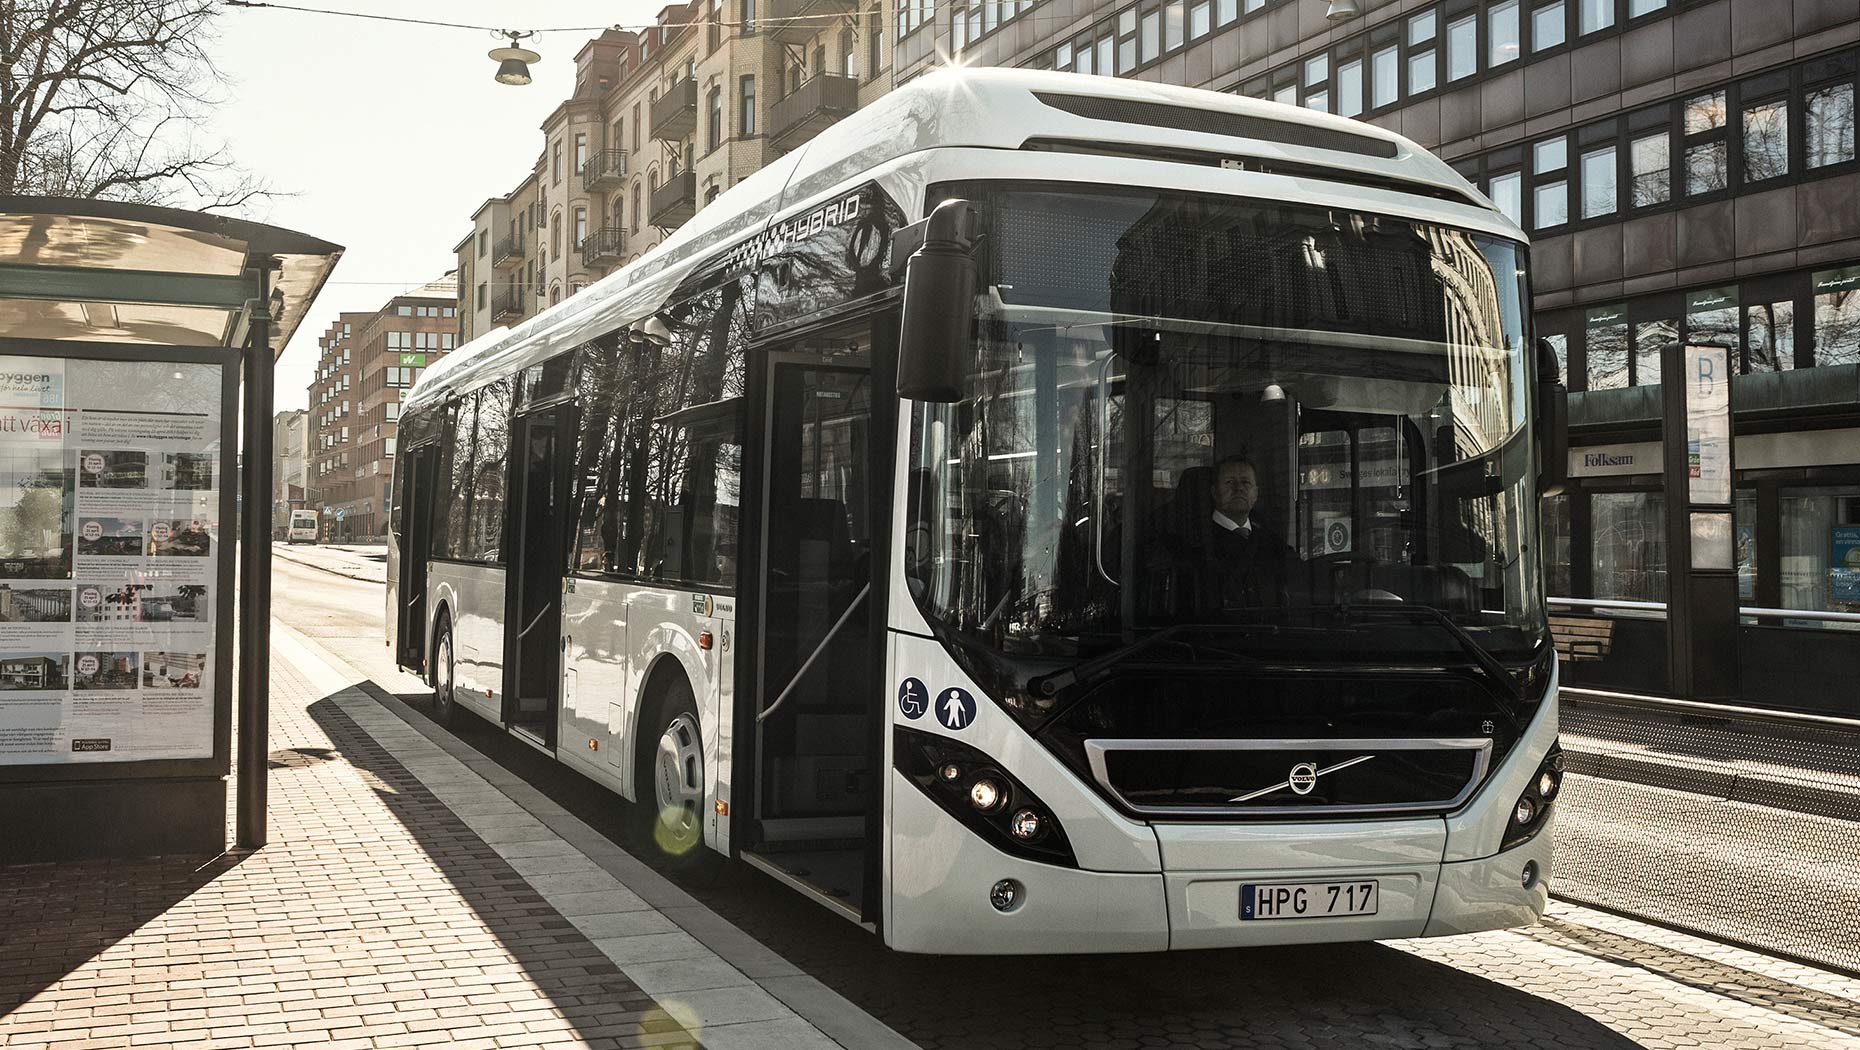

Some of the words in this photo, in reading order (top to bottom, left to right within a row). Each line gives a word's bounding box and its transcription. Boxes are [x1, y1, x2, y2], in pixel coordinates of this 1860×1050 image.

[784, 194, 860, 246] HYBRID
[20, 416, 61, 434] växa
[67, 416, 71, 434] i
[1584, 453, 1633, 467] Folksam
[1258, 887, 1307, 915] HPG
[1327, 884, 1373, 912] 717
